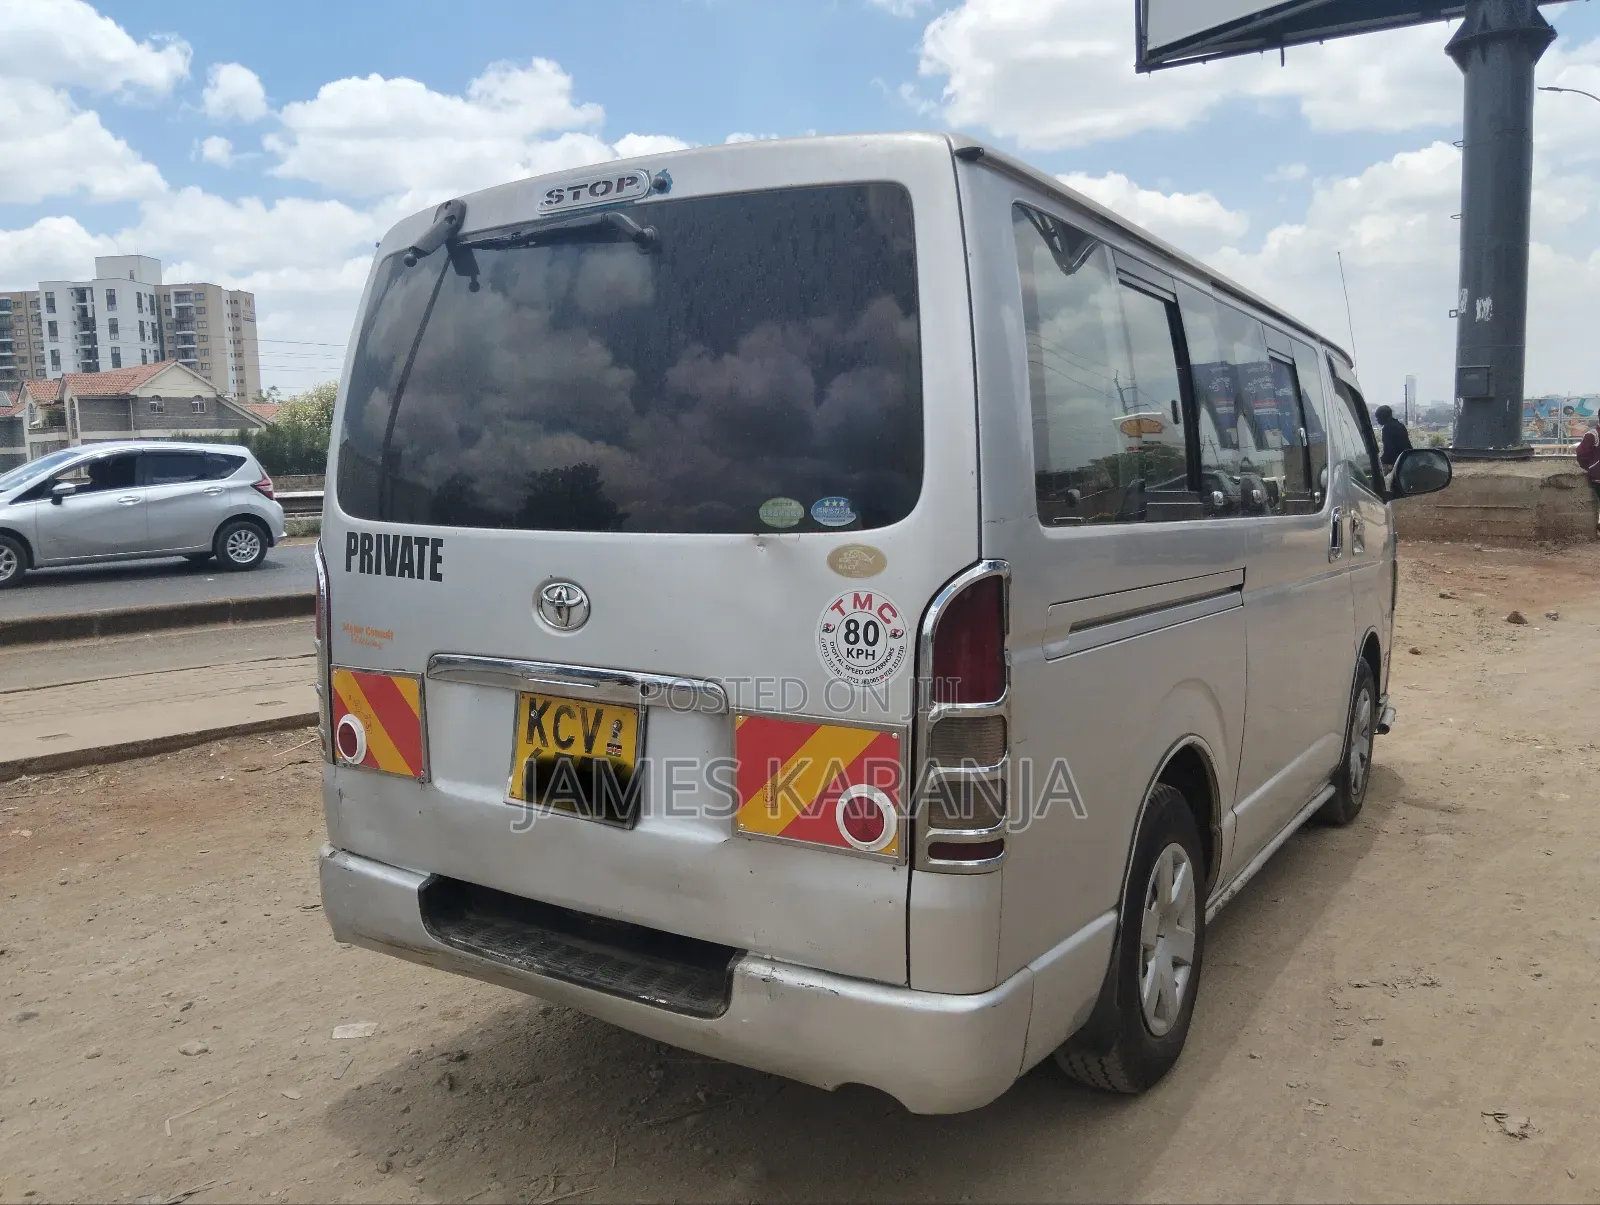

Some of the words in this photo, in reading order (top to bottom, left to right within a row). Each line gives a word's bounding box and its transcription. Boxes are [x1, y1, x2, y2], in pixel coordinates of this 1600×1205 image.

[544, 176, 639, 205] STOP
[345, 531, 444, 583] PRIVATE
[830, 592, 898, 625] TMC
[844, 618, 880, 647] 80
[829, 641, 844, 667] DIGITAL
[844, 664, 864, 675] SPEED
[864, 647, 895, 675] GOVERNORS
[846, 647, 876, 661] KPH
[525, 697, 605, 755] KCV
